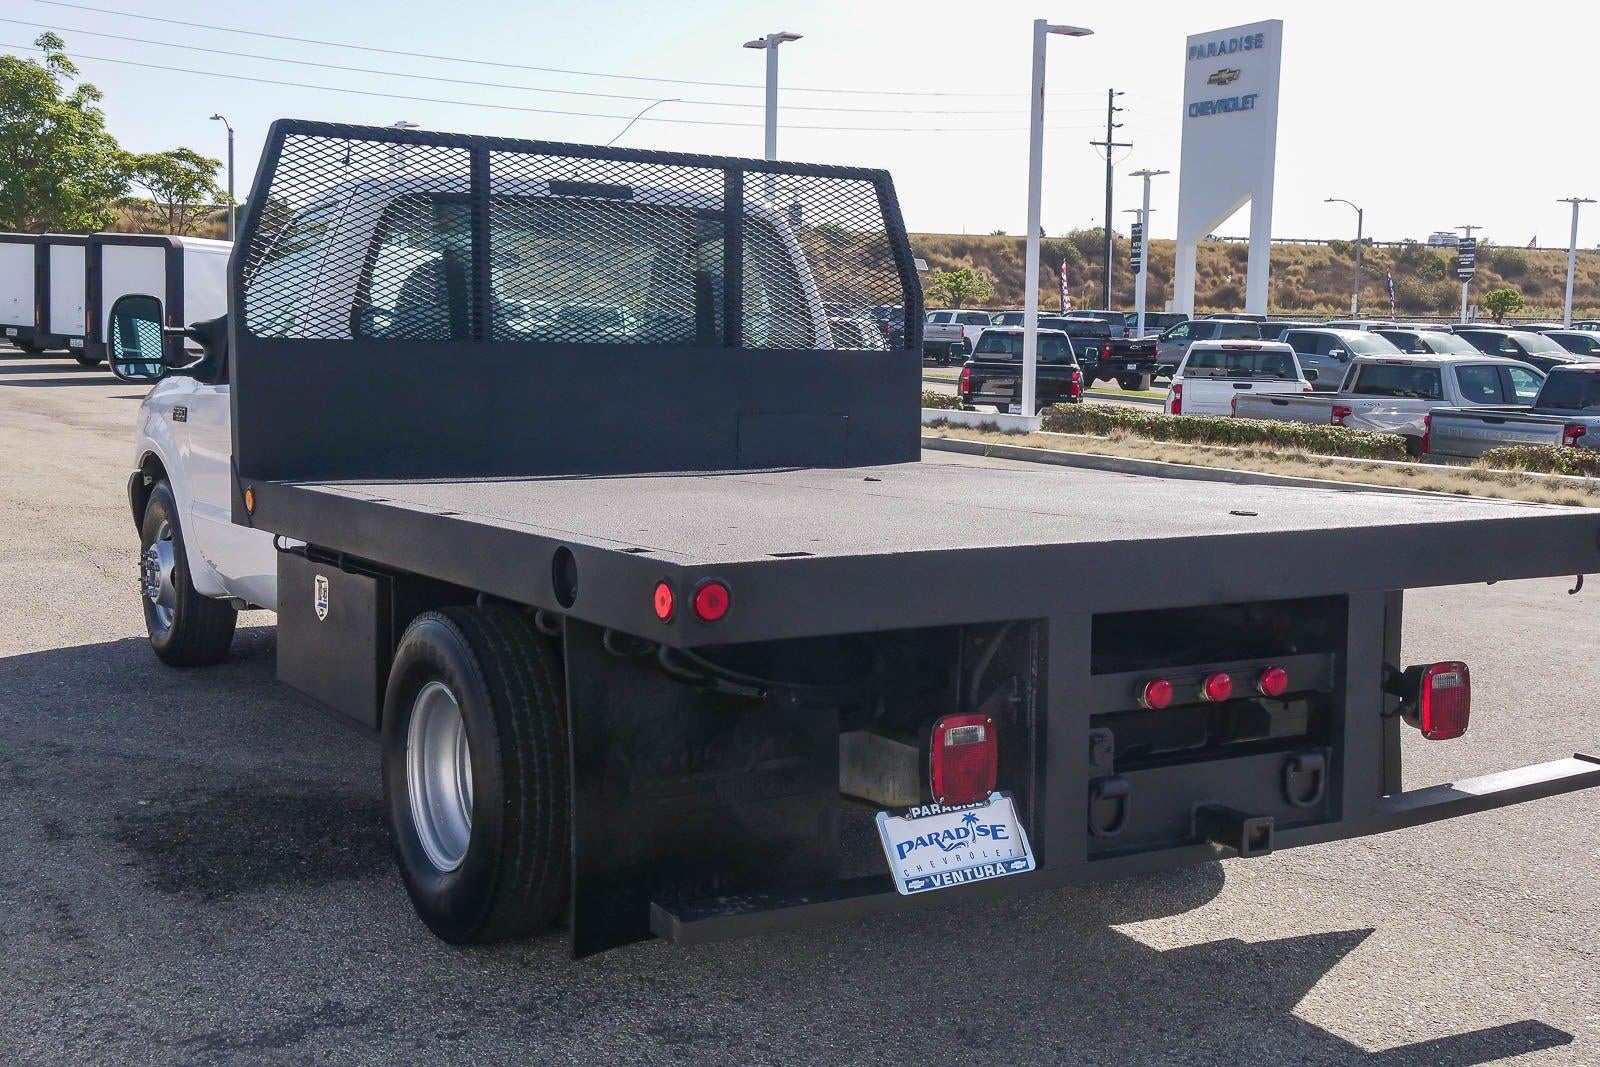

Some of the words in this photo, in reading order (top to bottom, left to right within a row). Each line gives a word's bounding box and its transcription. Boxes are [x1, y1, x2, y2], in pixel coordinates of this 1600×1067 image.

[1188, 33, 1264, 60] PARADISE
[1188, 94, 1258, 117] CHEVROLET
[896, 814, 1009, 860] PARADISE
[904, 849, 1015, 877] CHEVROLET
[930, 864, 1007, 887] VENTURA
